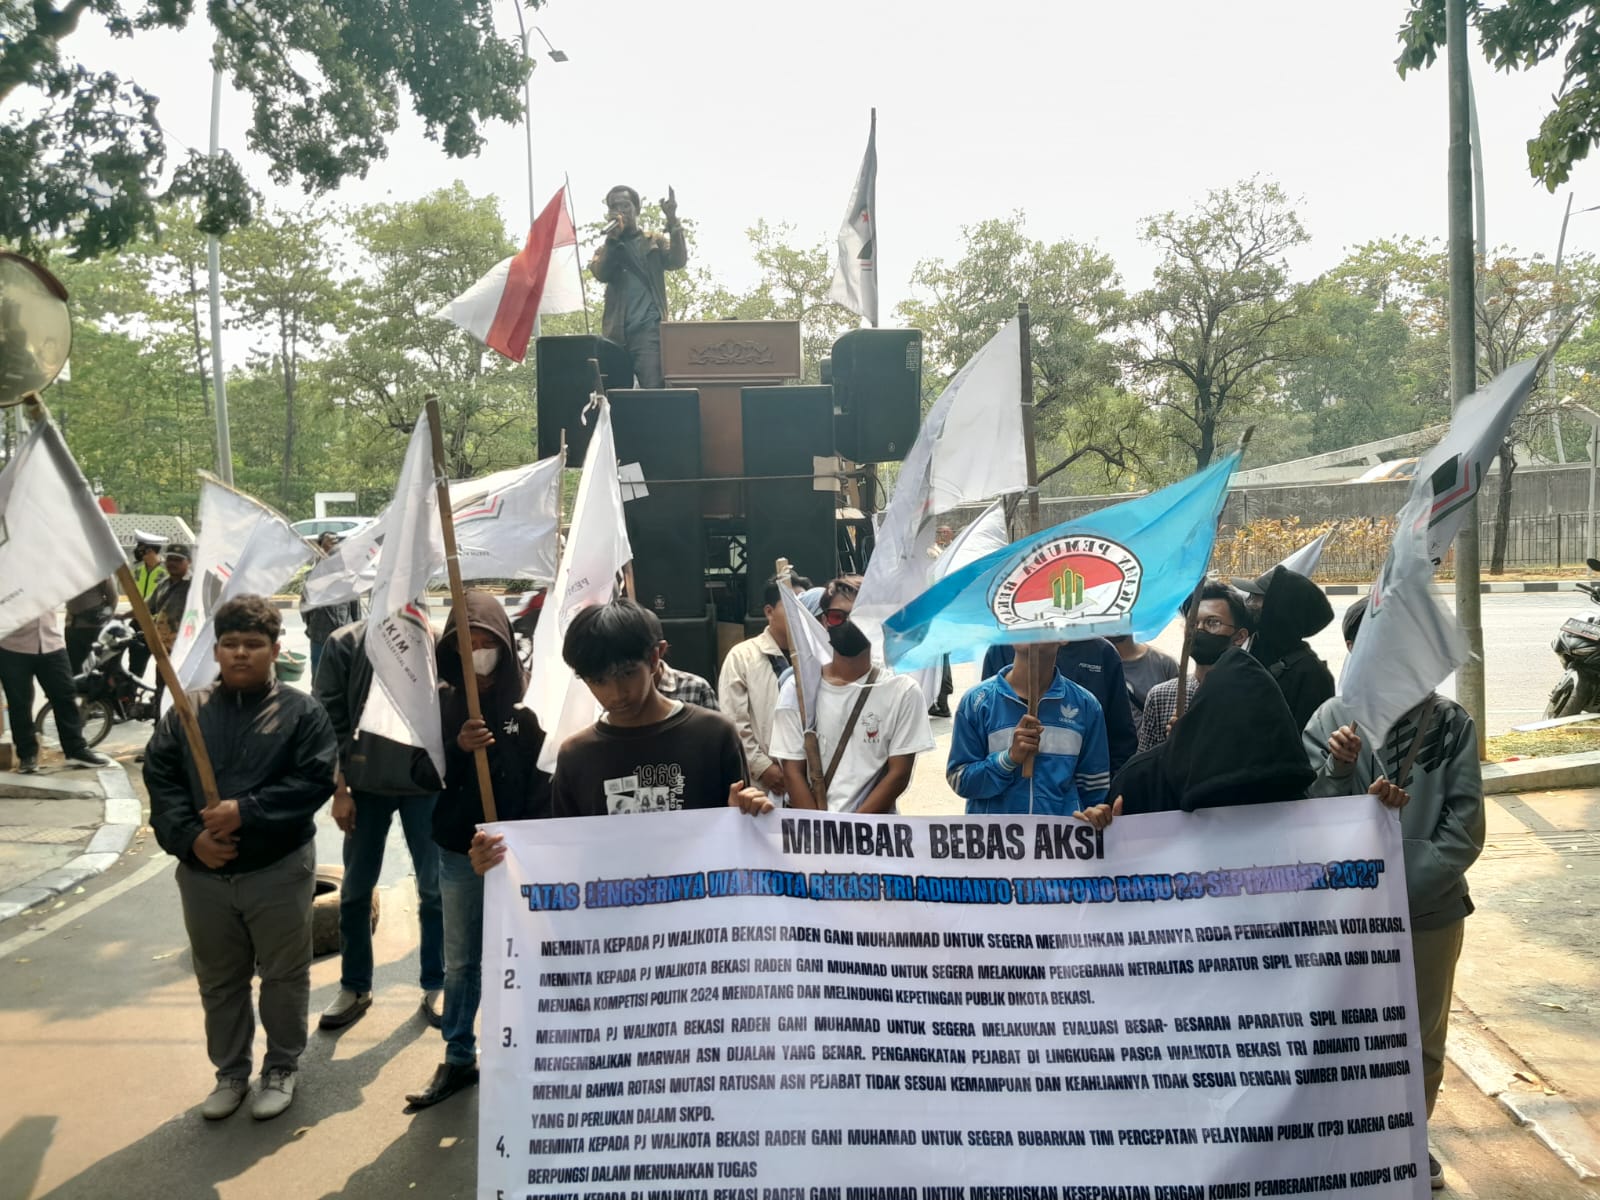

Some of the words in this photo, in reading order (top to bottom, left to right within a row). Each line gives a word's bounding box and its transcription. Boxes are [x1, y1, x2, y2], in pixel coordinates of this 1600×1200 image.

[782, 819, 914, 858] MIMBAR
[930, 823, 1025, 859] BEBAS
[1034, 824, 1104, 859] AKSI
[585, 873, 705, 908] LENGSERNYA
[708, 869, 807, 898] WALIKOTA
[809, 873, 880, 901] BEKASI
[881, 875, 917, 900] TRI
[917, 876, 1012, 904] ADHIANTO
[1012, 877, 1114, 904] TJAHYONO
[1115, 875, 1173, 901] RABU
[505, 937, 519, 957] 1.
[541, 939, 600, 956] MEMINTA
[604, 935, 649, 953] KEPADA
[652, 934, 665, 949] PJ
[668, 927, 728, 947] WALIKOTA
[732, 926, 776, 942] BEKASI
[780, 926, 821, 943] RADEN
[824, 929, 853, 946] GANI
[856, 932, 940, 948] MUHAMMAD
[943, 932, 986, 948] UNTUK
[987, 933, 1034, 949] SEGERA
[1128, 928, 1195, 946] JALANNYA
[1195, 926, 1233, 942] RODA
[1234, 920, 1339, 940] PEMERINTAHAN
[1340, 918, 1368, 934] KOTA
[1368, 917, 1405, 933] BEKASI.
[504, 969, 521, 989] 2.
[540, 972, 592, 987] MEMINTA
[597, 968, 636, 984] KEPADA
[640, 967, 651, 981] PJ
[655, 961, 707, 979] WALIKOTA
[711, 959, 750, 974] BEKASI
[755, 959, 791, 972] RADEN
[796, 958, 823, 973] GANI
[827, 960, 887, 977] MUHAMAD
[891, 964, 928, 979] UNTUK
[932, 965, 974, 979] SEGERA
[978, 965, 1046, 980] MELAKUKAN
[1049, 963, 1124, 979] PENCEGAHAN
[1128, 960, 1194, 976] NETRALITAS
[1198, 956, 1259, 973] APARATUR
[1262, 954, 1292, 969] SIPIL
[1294, 952, 1343, 967] NEGARA
[1371, 949, 1400, 964] DALAM
[538, 998, 591, 1012] MENJAGA
[594, 993, 649, 1011] KOMPETISI
[650, 989, 688, 1006] POLITIK
[691, 987, 719, 1002] 2024
[722, 984, 793, 1000] MENDATANG
[797, 985, 820, 999] DAN
[824, 985, 894, 1002] MELINDUNGI
[965, 991, 1005, 1006] PUBLIK
[1008, 992, 1049, 1006] DIKOTA
[1051, 990, 1095, 1005] BEKASI.
[502, 1026, 518, 1048] 3.
[606, 1027, 617, 1041] PJ
[624, 1021, 677, 1040] WALIKOTA
[684, 1018, 724, 1035] BEKASI
[731, 1017, 770, 1032] RADEN
[778, 1016, 807, 1031] GANI
[814, 1016, 880, 1033] MUHAMAD
[887, 1019, 926, 1035] UNTUK
[932, 1021, 976, 1037] SEGERA
[982, 1022, 1056, 1037] MELAKUKAN
[1062, 1020, 1119, 1036] EVALUASI
[1125, 1018, 1168, 1034] BESAR-
[1174, 1016, 1231, 1032] BESARAN
[1238, 1012, 1304, 1030] APARATUR
[1309, 1011, 1337, 1026] SIPIL
[1342, 1008, 1378, 1024] NEGARA
[534, 1053, 632, 1071] MENGEMBALIKAN
[637, 1049, 690, 1066] MARWAH
[696, 1047, 720, 1063] ASN
[727, 1046, 775, 1061] DIJALAN
[782, 1045, 815, 1060] YANG
[822, 1045, 866, 1060] BENAR.
[872, 1046, 966, 1064] PENGANGKATAN
[972, 1050, 1020, 1064] PEJABAT
[1027, 1049, 1040, 1064] DI
[1121, 1046, 1162, 1061] PASCA
[1167, 1044, 1231, 1060] WALIKOTA
[1236, 1041, 1281, 1058] BEKASI
[1286, 1040, 1307, 1056] TRI
[1313, 1037, 1360, 1055] ADHIANTO
[533, 1084, 582, 1100] MENILAI
[586, 1081, 624, 1098] BAHWA
[628, 1078, 665, 1096] ROTASI
[670, 1076, 715, 1093] MUTASI
[720, 1075, 775, 1091] RATUSAN
[780, 1074, 805, 1089] ASN
[810, 1074, 861, 1089] PEJABAT
[865, 1074, 900, 1090] TIDAK
[904, 1075, 947, 1091] SESUAI
[950, 1076, 1032, 1092] KEMAMPUAN
[1035, 1076, 1061, 1092] DAN
[1065, 1074, 1150, 1091] KEAHLIANNYA
[1152, 1074, 1189, 1089] TIDAK
[1192, 1072, 1237, 1088] SESUAI
[1239, 1070, 1291, 1086] DENGAN
[1295, 1067, 1338, 1085] SUMBER
[1341, 1065, 1368, 1081] DAYA
[1369, 1060, 1410, 1079] MANUSIA
[495, 1135, 510, 1158] 4.
[529, 1138, 584, 1155] MEMINTA
[588, 1135, 629, 1152] KEPADA
[634, 1135, 646, 1150] PJ
[651, 1132, 711, 1149] WALIKOTA
[716, 1130, 759, 1148] BEKASI
[765, 1130, 806, 1146] RADEN
[811, 1129, 842, 1145] GANI
[848, 1129, 917, 1145] MUHAMAD
[921, 1130, 963, 1146] UNTUK
[967, 1130, 1014, 1146] SEGERA
[1017, 1130, 1086, 1146] BUBARKAN
[1089, 1130, 1114, 1146] TIM
[1118, 1128, 1198, 1145] PERCEPATAN
[1202, 1126, 1273, 1144] PELAYANAN
[1277, 1123, 1314, 1141] PUBLIK
[1318, 1120, 1344, 1137] (TP3)
[1347, 1116, 1385, 1134] KARENA
[1388, 1112, 1414, 1129] GAGAL
[532, 1113, 564, 1128] YANG
[567, 1113, 578, 1128] DI
[581, 1109, 634, 1127] PERLUKAN
[637, 1107, 676, 1124] DALAM
[679, 1106, 714, 1122] SKPD.
[591, 1165, 631, 1182] DALAM
[634, 1162, 714, 1181] MENUNAIKAN
[717, 1161, 757, 1178] TUGAS
[1209, 1182, 1250, 1200] KOMISI
[1255, 1173, 1347, 1196] PEMBERANTASAN
[1350, 1167, 1392, 1188] KORUPSI
